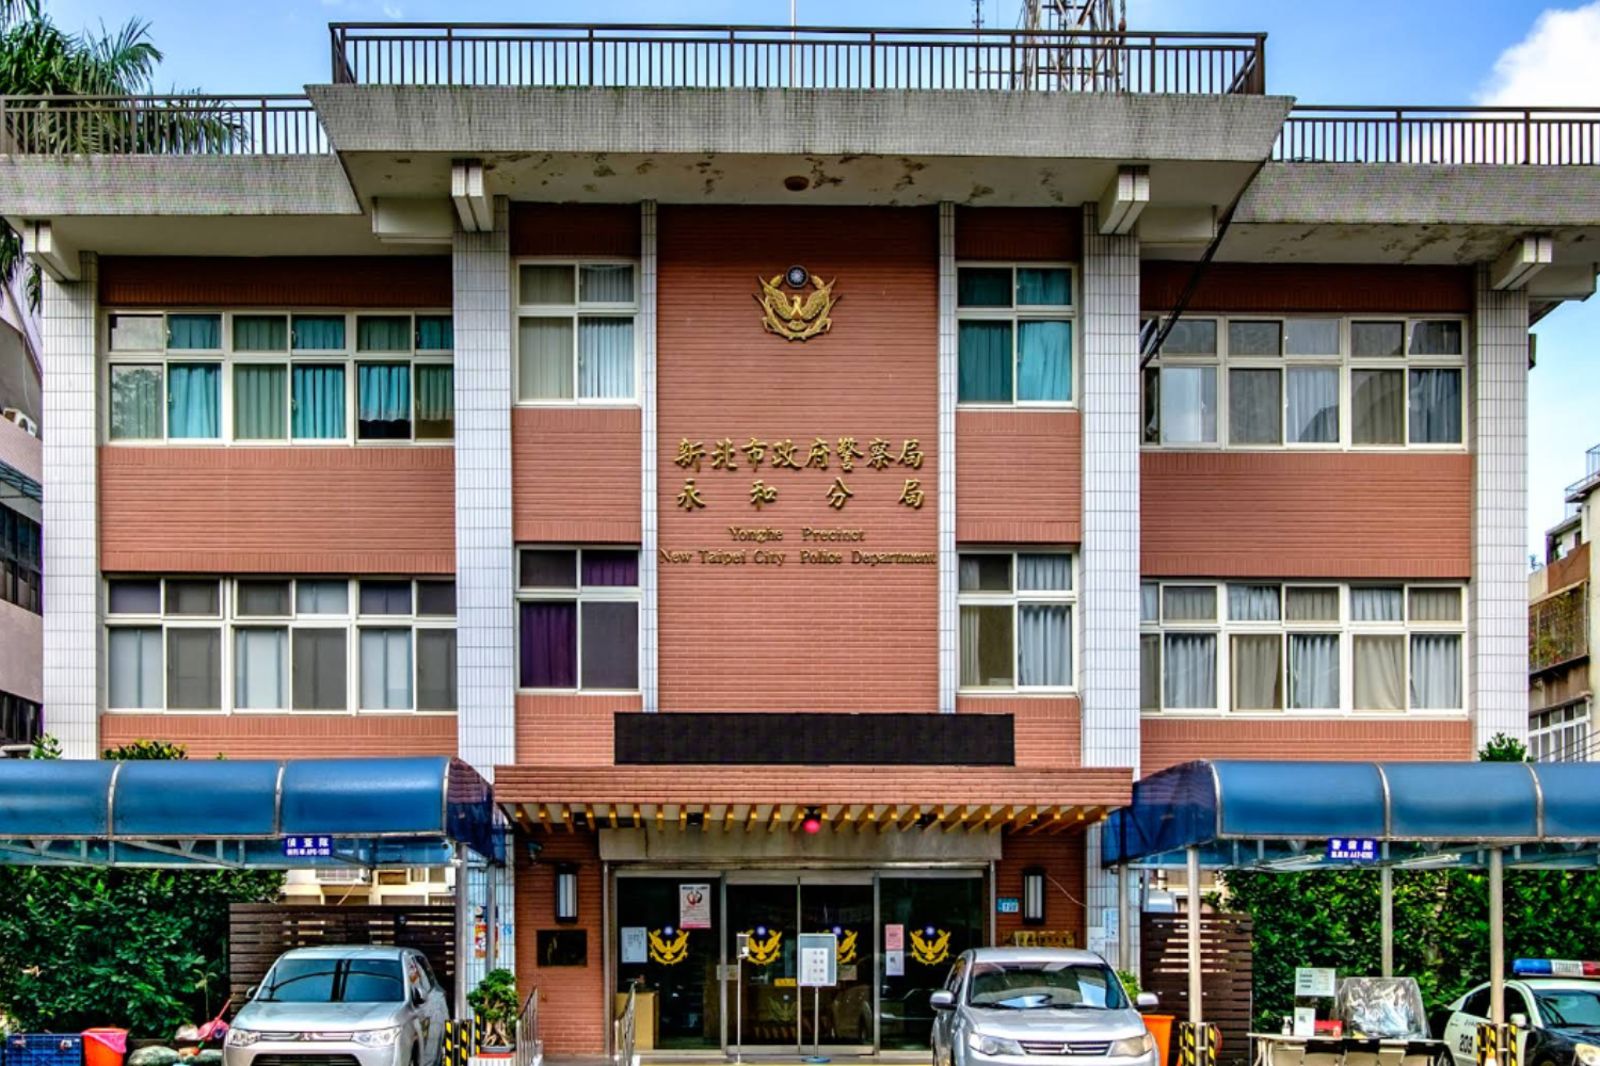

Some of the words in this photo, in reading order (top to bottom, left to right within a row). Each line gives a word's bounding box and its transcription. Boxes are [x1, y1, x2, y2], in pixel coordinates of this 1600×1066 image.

[674, 437, 924, 473] 新北市政府警察局
[677, 476, 925, 512] 永和分局
[728, 526, 784, 543] Yonghe
[802, 526, 866, 542] Precinct
[660, 548, 692, 564] New
[698, 549, 746, 565] Taipei
[753, 549, 786, 566] City
[800, 549, 842, 565] Police
[851, 549, 937, 567] Department
